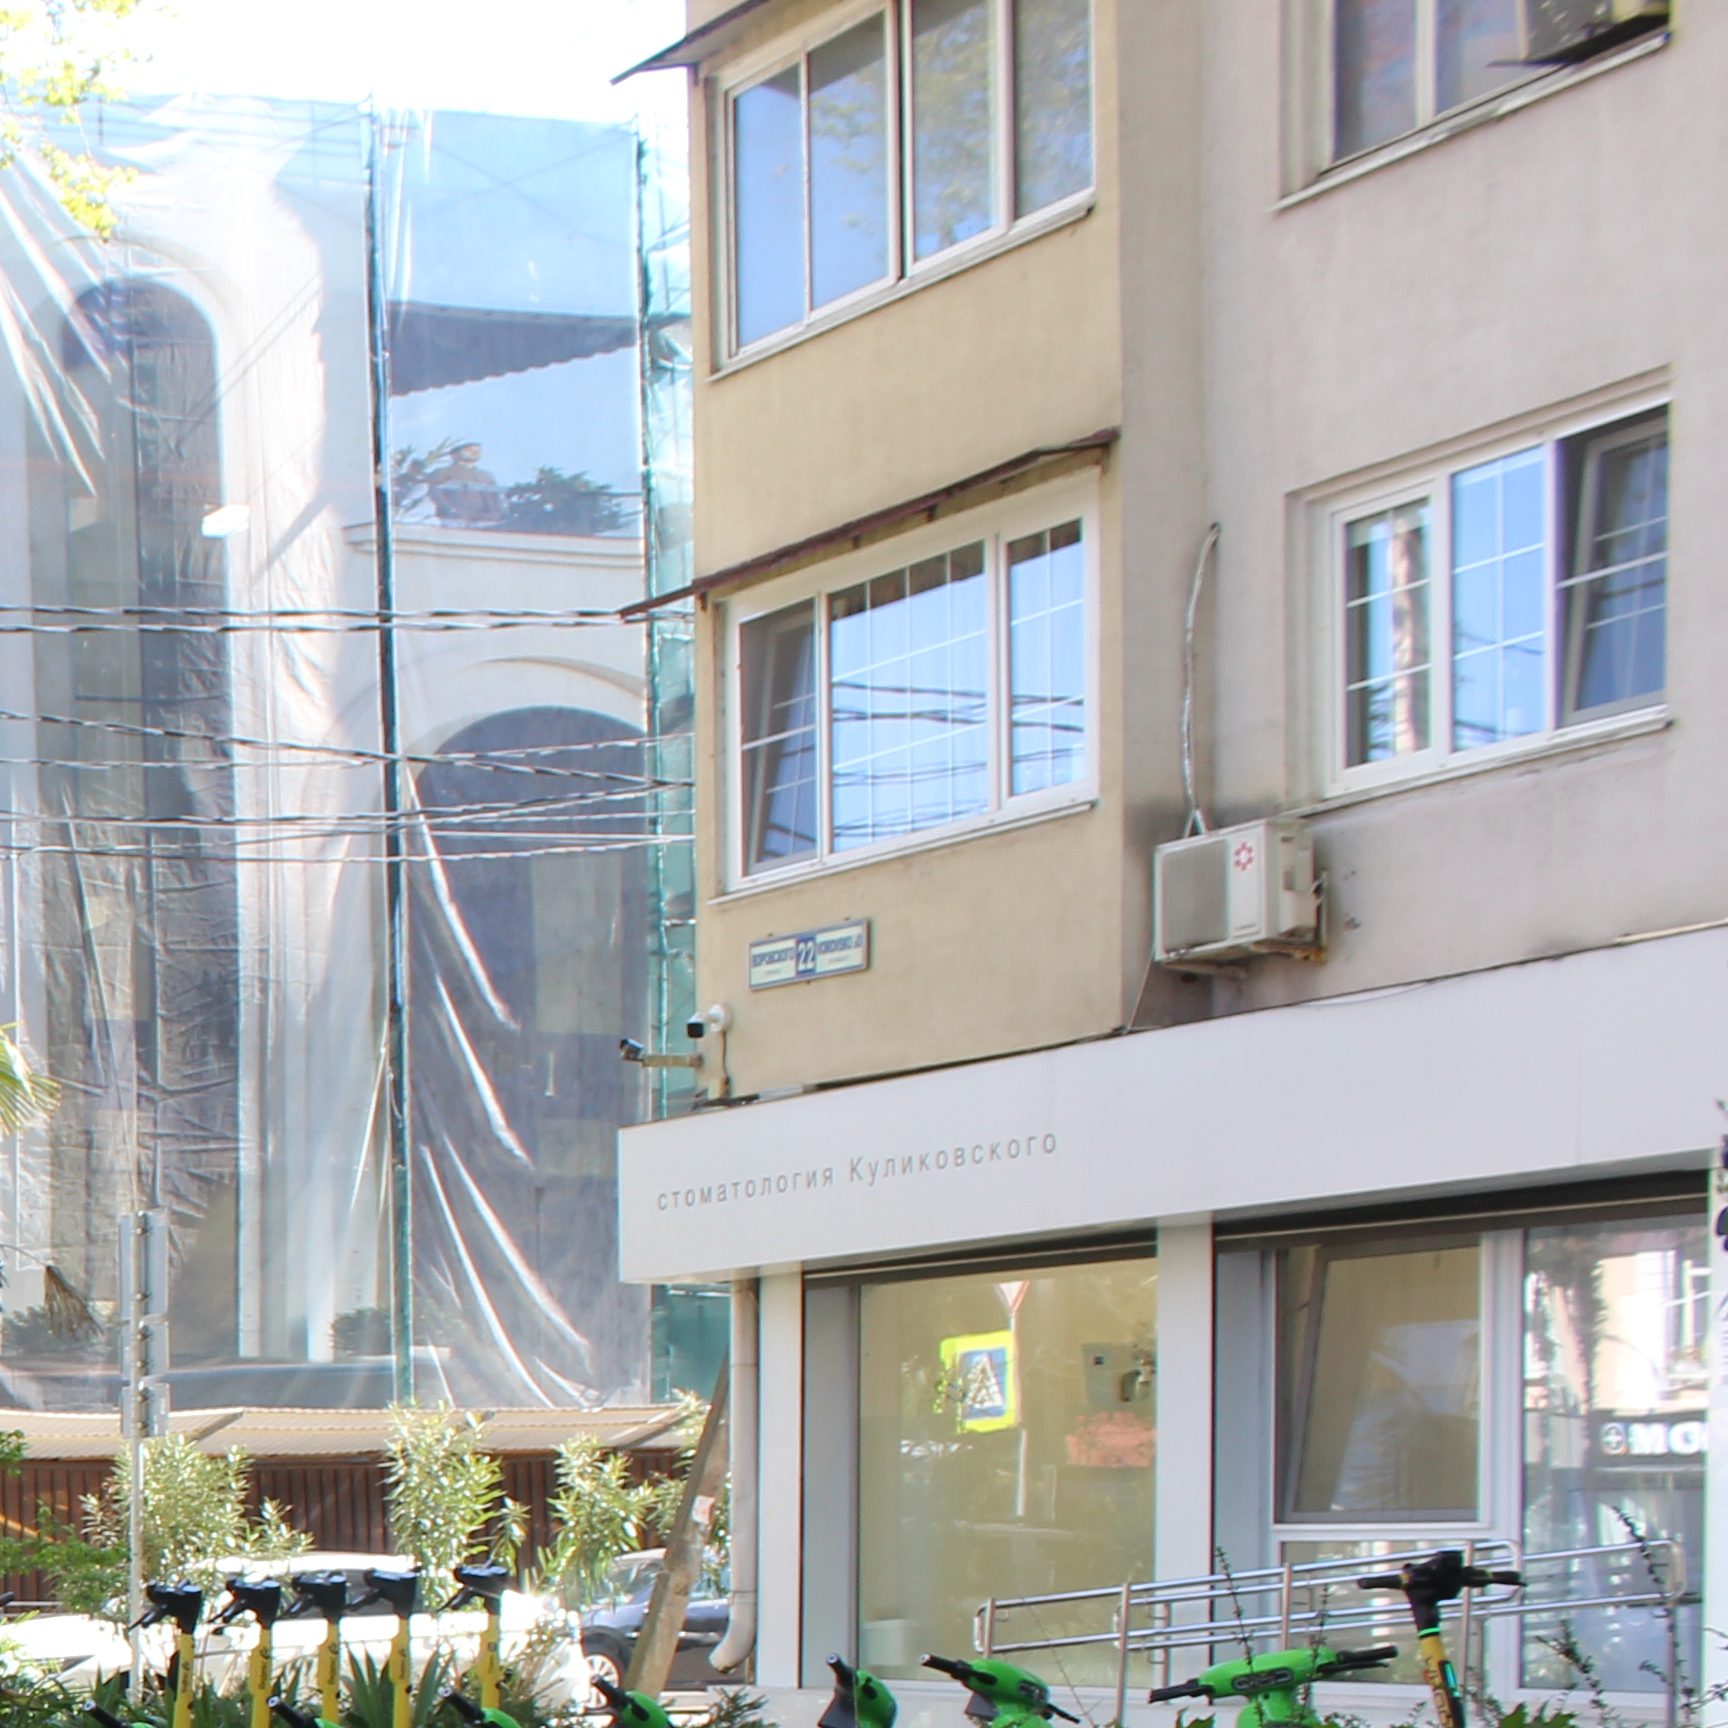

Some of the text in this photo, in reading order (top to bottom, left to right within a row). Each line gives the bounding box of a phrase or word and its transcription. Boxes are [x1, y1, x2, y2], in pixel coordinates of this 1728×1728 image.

[798, 941, 816, 972] 22
[657, 1132, 1058, 1211] стоматология Куликовского
